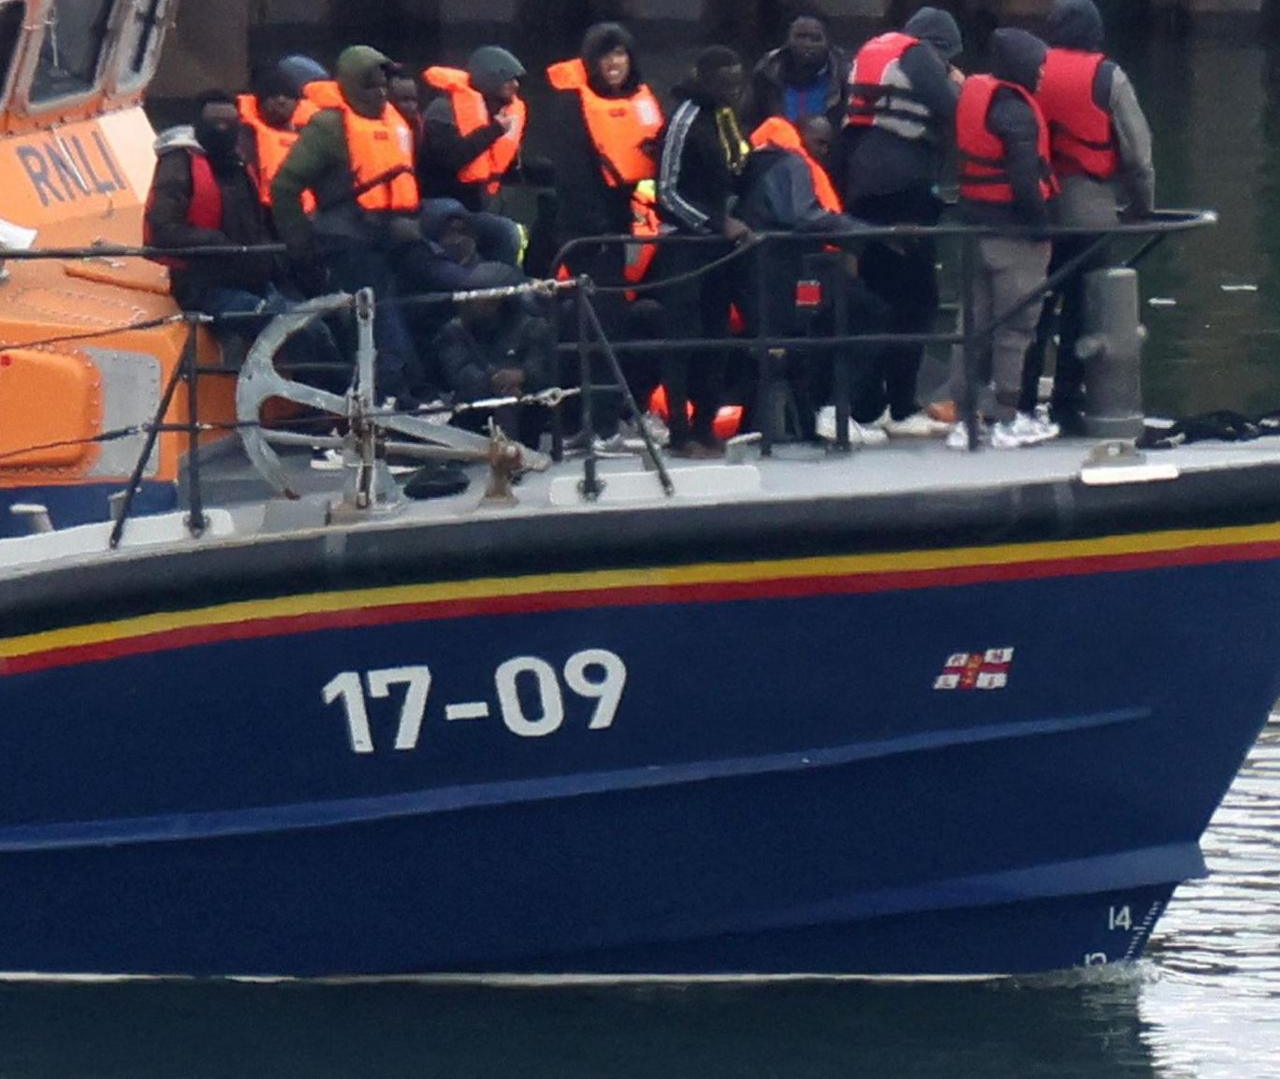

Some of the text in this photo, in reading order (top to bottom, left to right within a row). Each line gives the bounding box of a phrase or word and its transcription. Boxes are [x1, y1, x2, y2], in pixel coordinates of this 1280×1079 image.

[17, 130, 126, 207] RNLI
[321, 648, 628, 754] 17-09
[1108, 906, 1132, 931] 14
